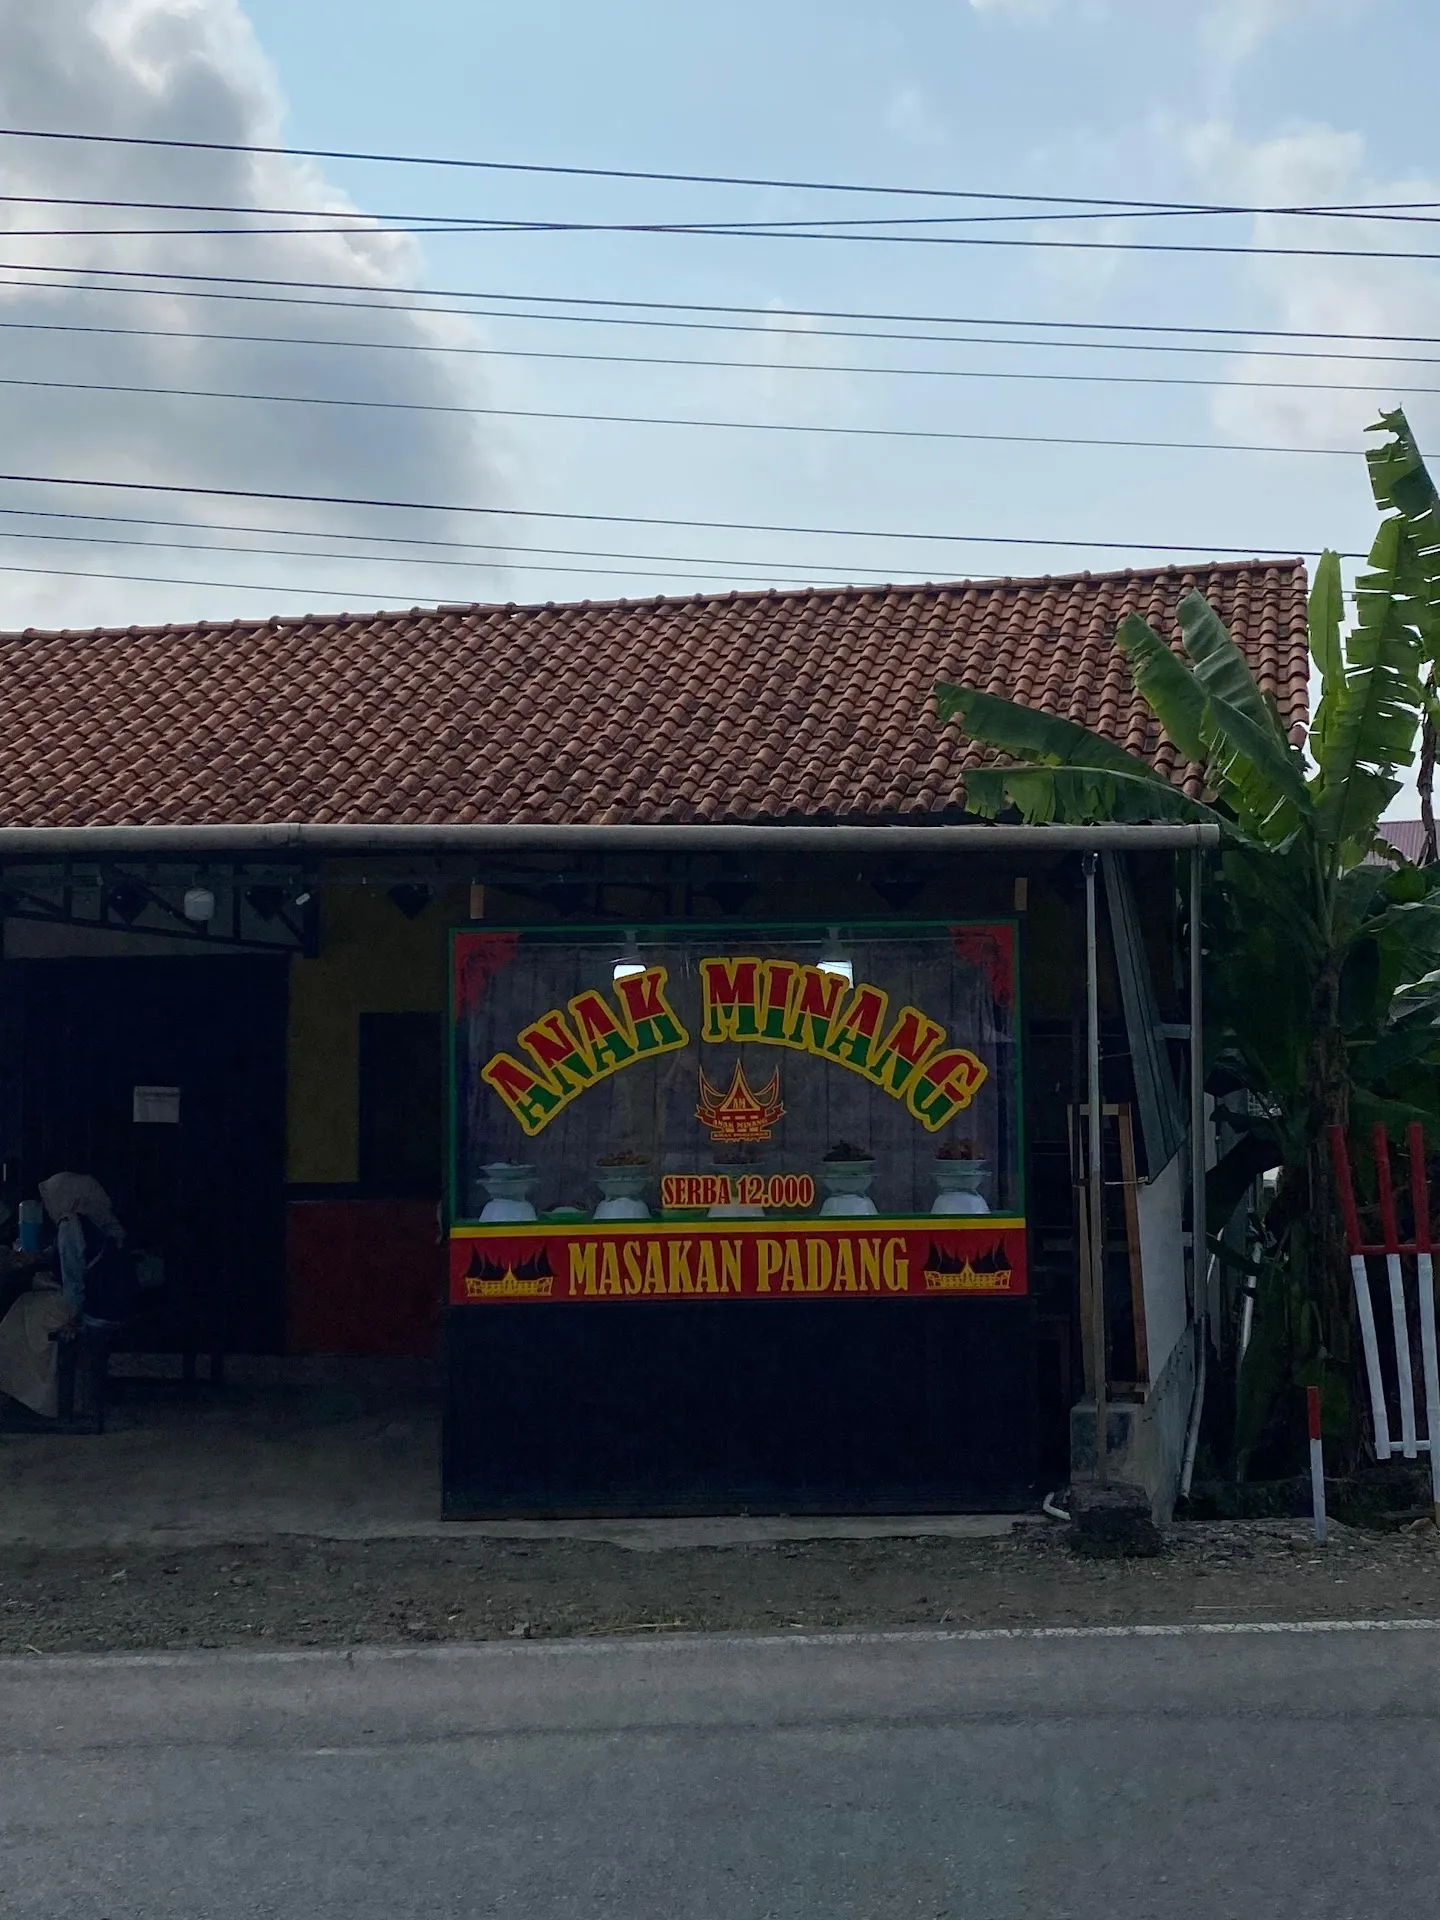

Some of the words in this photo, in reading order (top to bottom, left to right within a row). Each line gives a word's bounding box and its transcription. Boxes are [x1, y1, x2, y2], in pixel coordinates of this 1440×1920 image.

[482, 966, 688, 1135] ANAK
[701, 957, 988, 1132] MINANG
[662, 1175, 732, 1207] SERBA
[737, 1175, 814, 1207] 12.000
[567, 1239, 743, 1296] MASAKAN
[755, 1237, 908, 1292] PADANG
